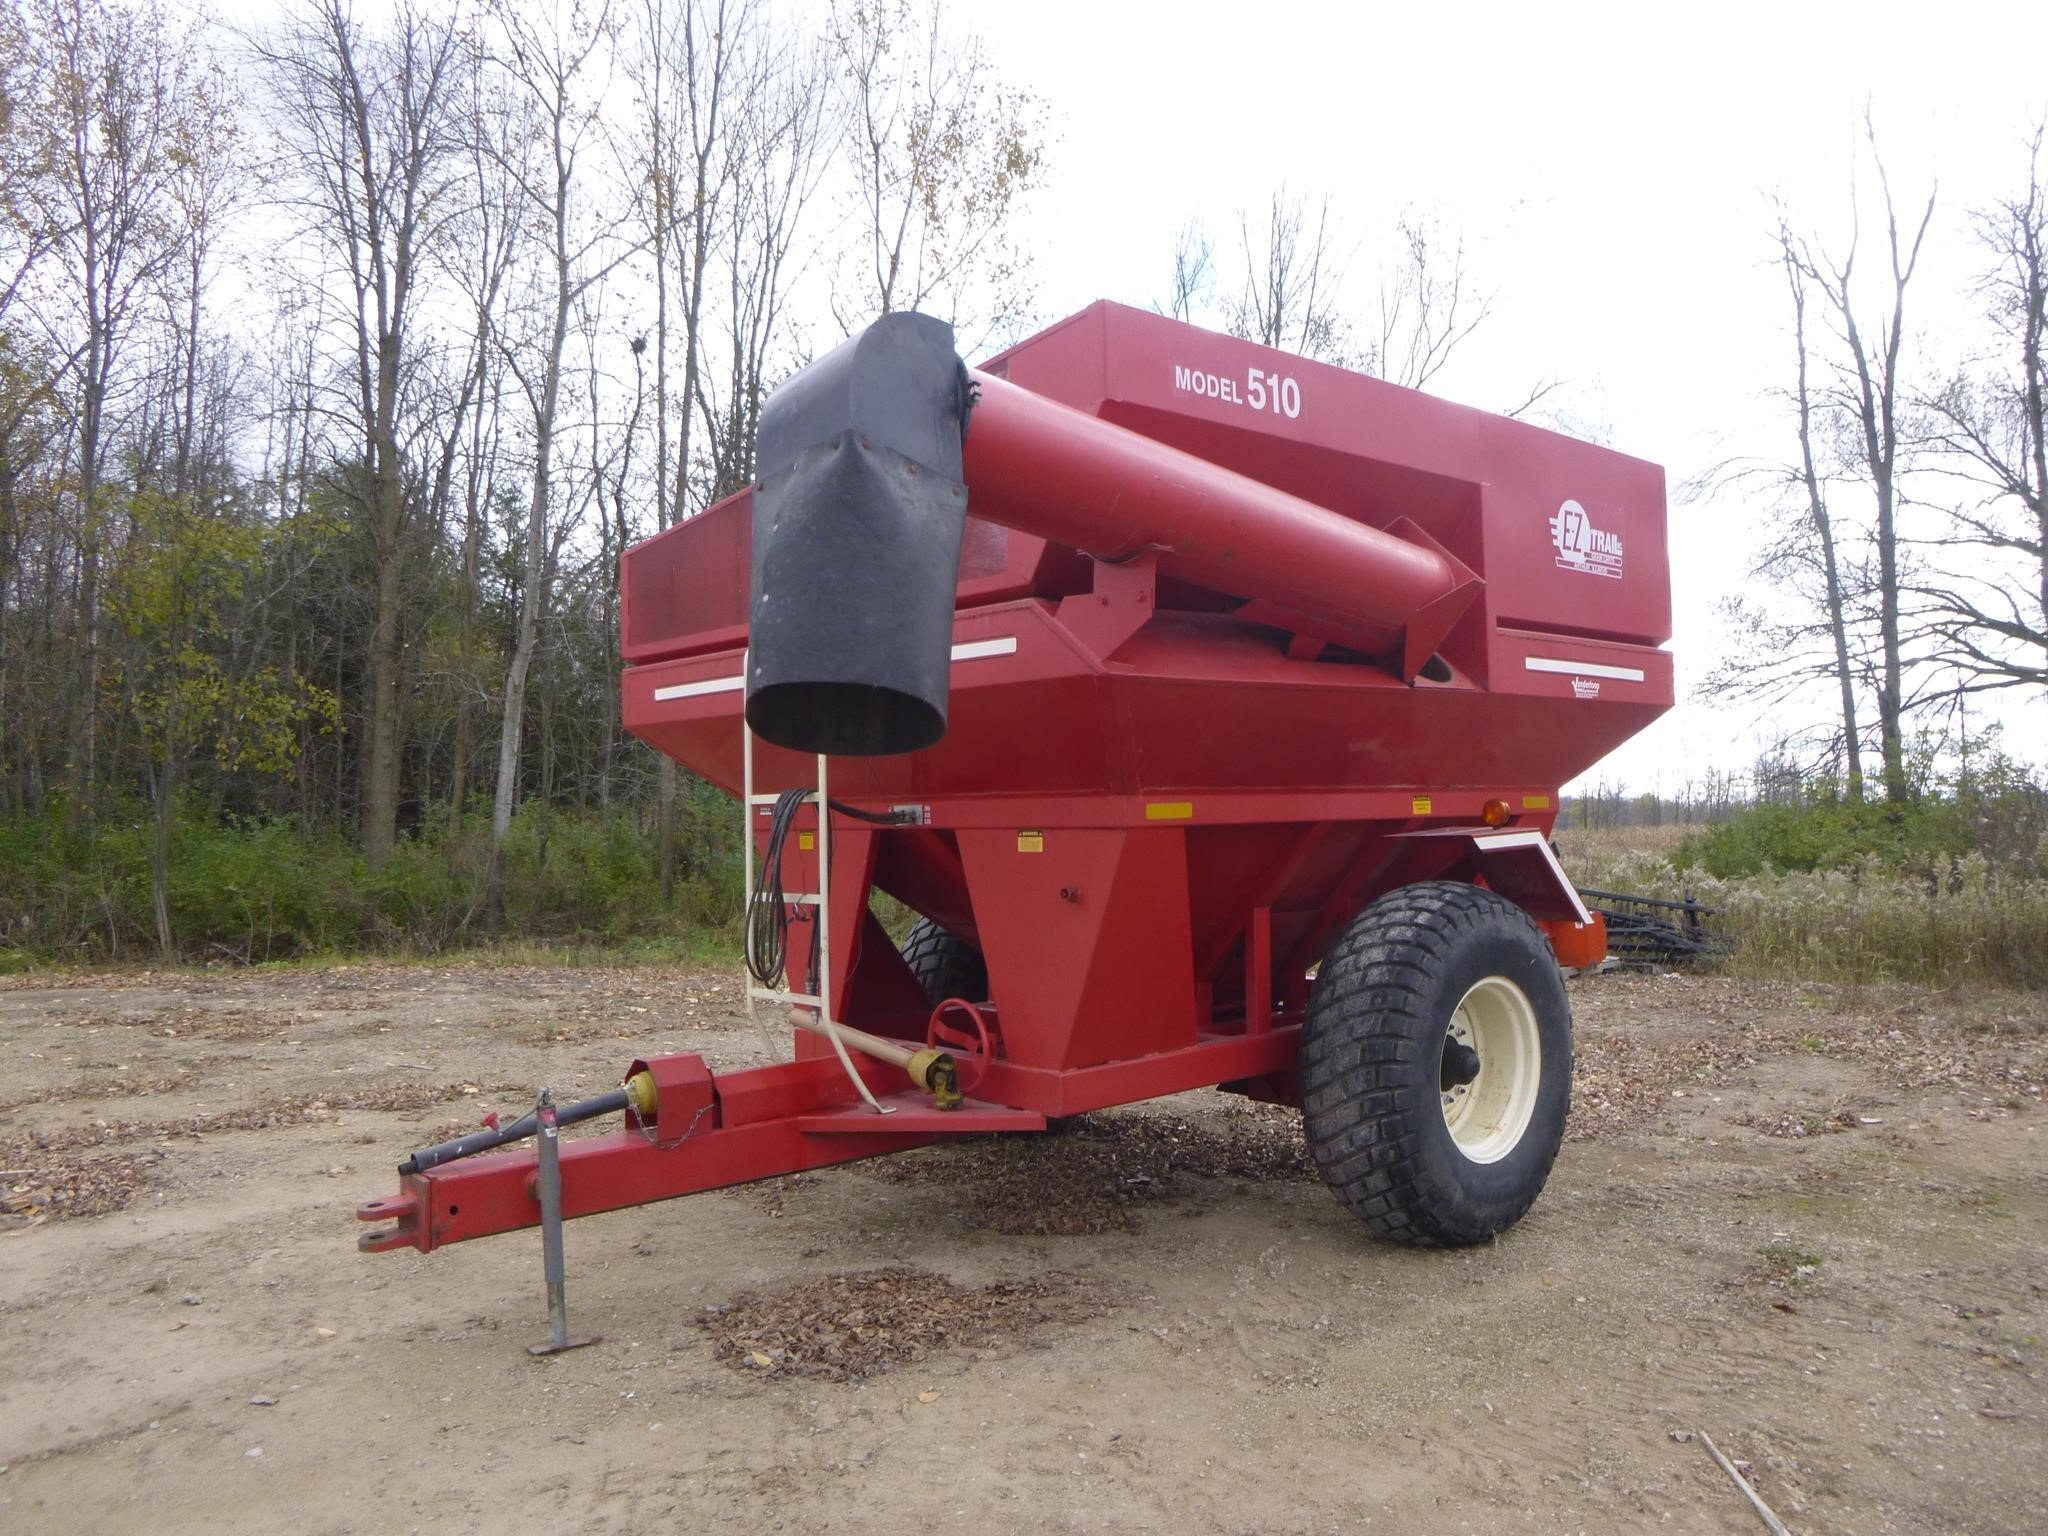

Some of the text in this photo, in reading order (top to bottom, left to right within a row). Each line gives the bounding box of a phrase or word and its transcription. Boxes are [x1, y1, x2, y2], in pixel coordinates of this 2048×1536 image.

[1175, 365, 1301, 419] MODEL 510
[1590, 528, 1622, 557] TRAIL
